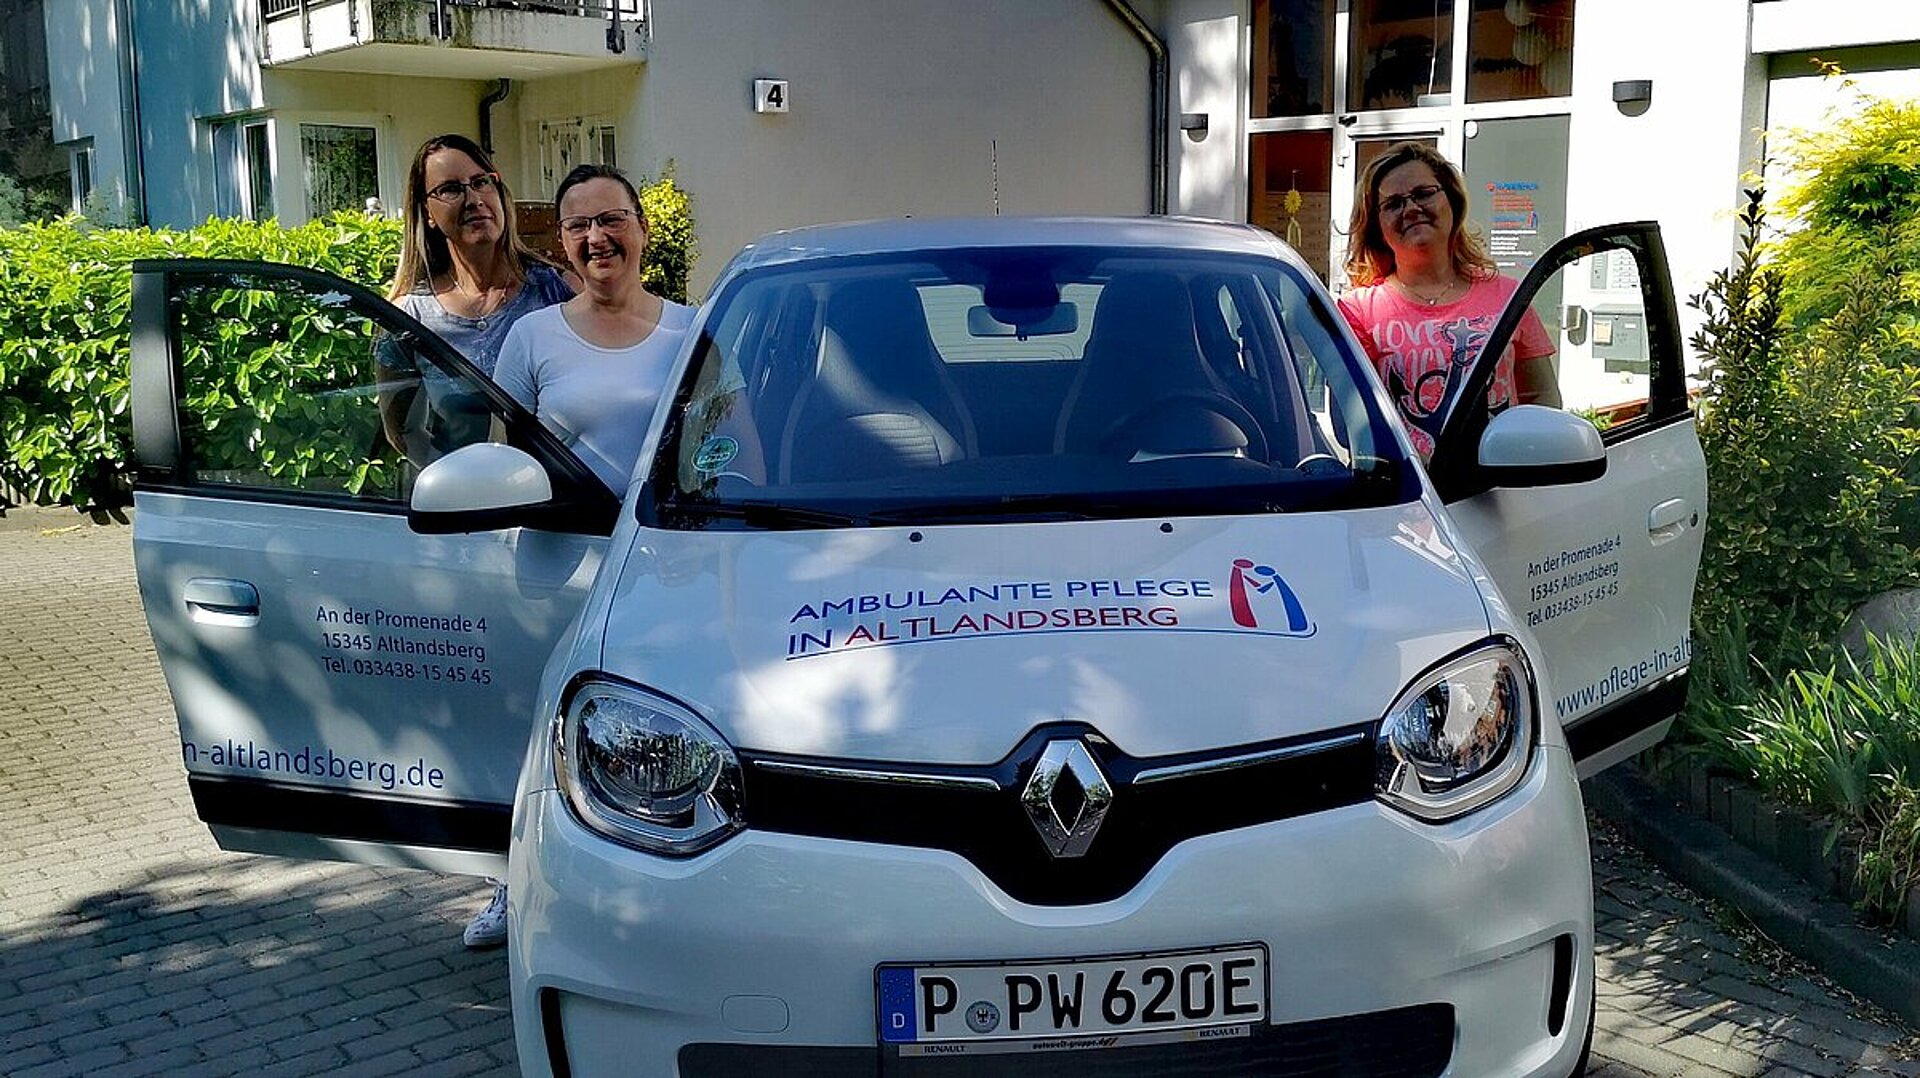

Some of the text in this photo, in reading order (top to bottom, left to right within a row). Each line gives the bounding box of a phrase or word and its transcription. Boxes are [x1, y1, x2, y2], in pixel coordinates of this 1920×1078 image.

[767, 84, 783, 108] 4
[1372, 319, 1442, 351] LOVE
[1527, 534, 1622, 578] An der Promenade 4
[1530, 561, 1619, 602] 15345 Altlandsberg
[789, 579, 1214, 623] AMBULANTE PFLEGE
[316, 605, 488, 633] An der Promenade 4
[787, 607, 1179, 655] IN ALTLANDSBERG
[1527, 611, 1543, 627] Tel.
[322, 632, 486, 663] 15345 Altlandsberg
[322, 656, 492, 685] Tel. 033438-15 45 45
[919, 957, 1259, 1032] P PW 620E
[892, 1013, 905, 1028] D
[1199, 1027, 1242, 1038] RENAULT
[924, 1045, 967, 1054] RENAULT
